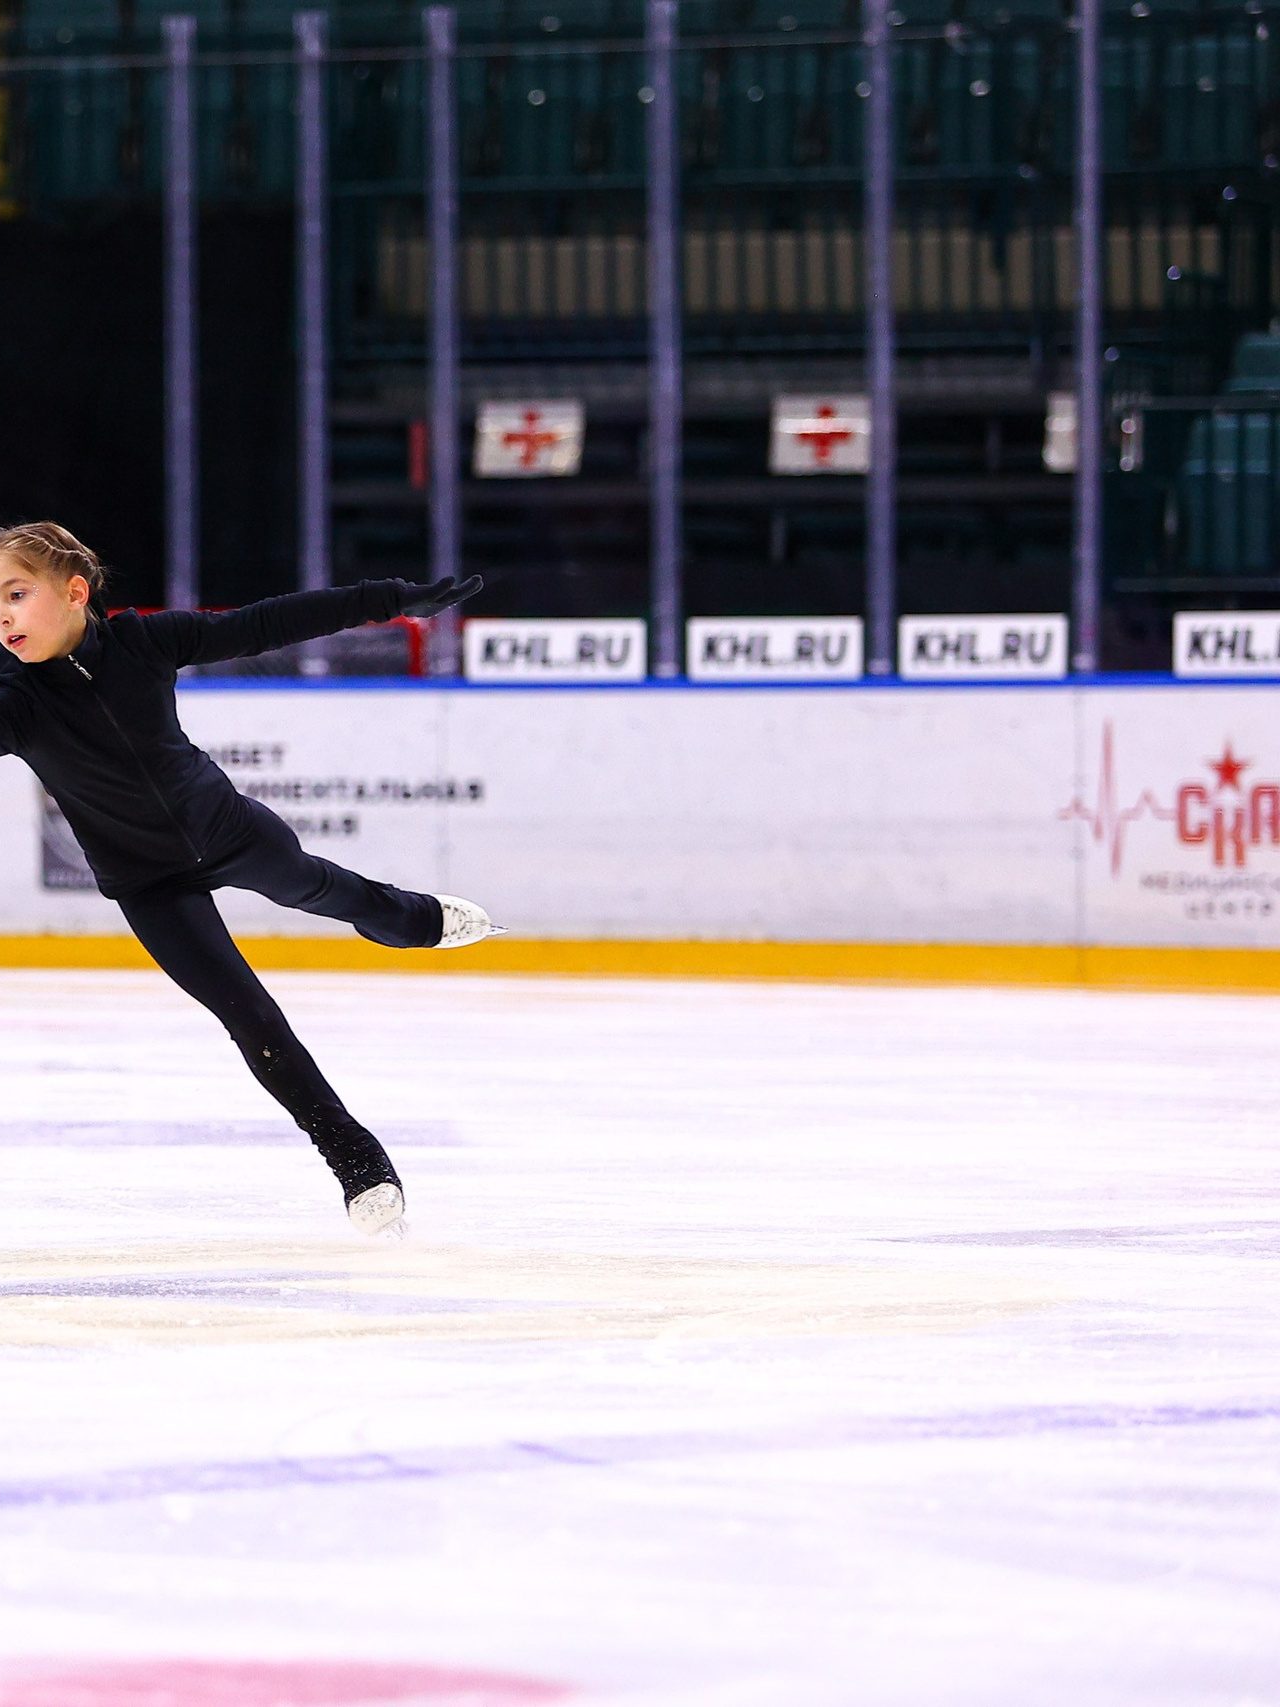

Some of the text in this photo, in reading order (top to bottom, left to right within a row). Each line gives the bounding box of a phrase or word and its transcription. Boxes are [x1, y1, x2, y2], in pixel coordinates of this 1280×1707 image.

[479, 633, 632, 668] KHL.RU
[701, 631, 849, 667] KHL.RU
[911, 629, 1054, 665] KHL.RU
[1187, 628, 1280, 663] KHL.
